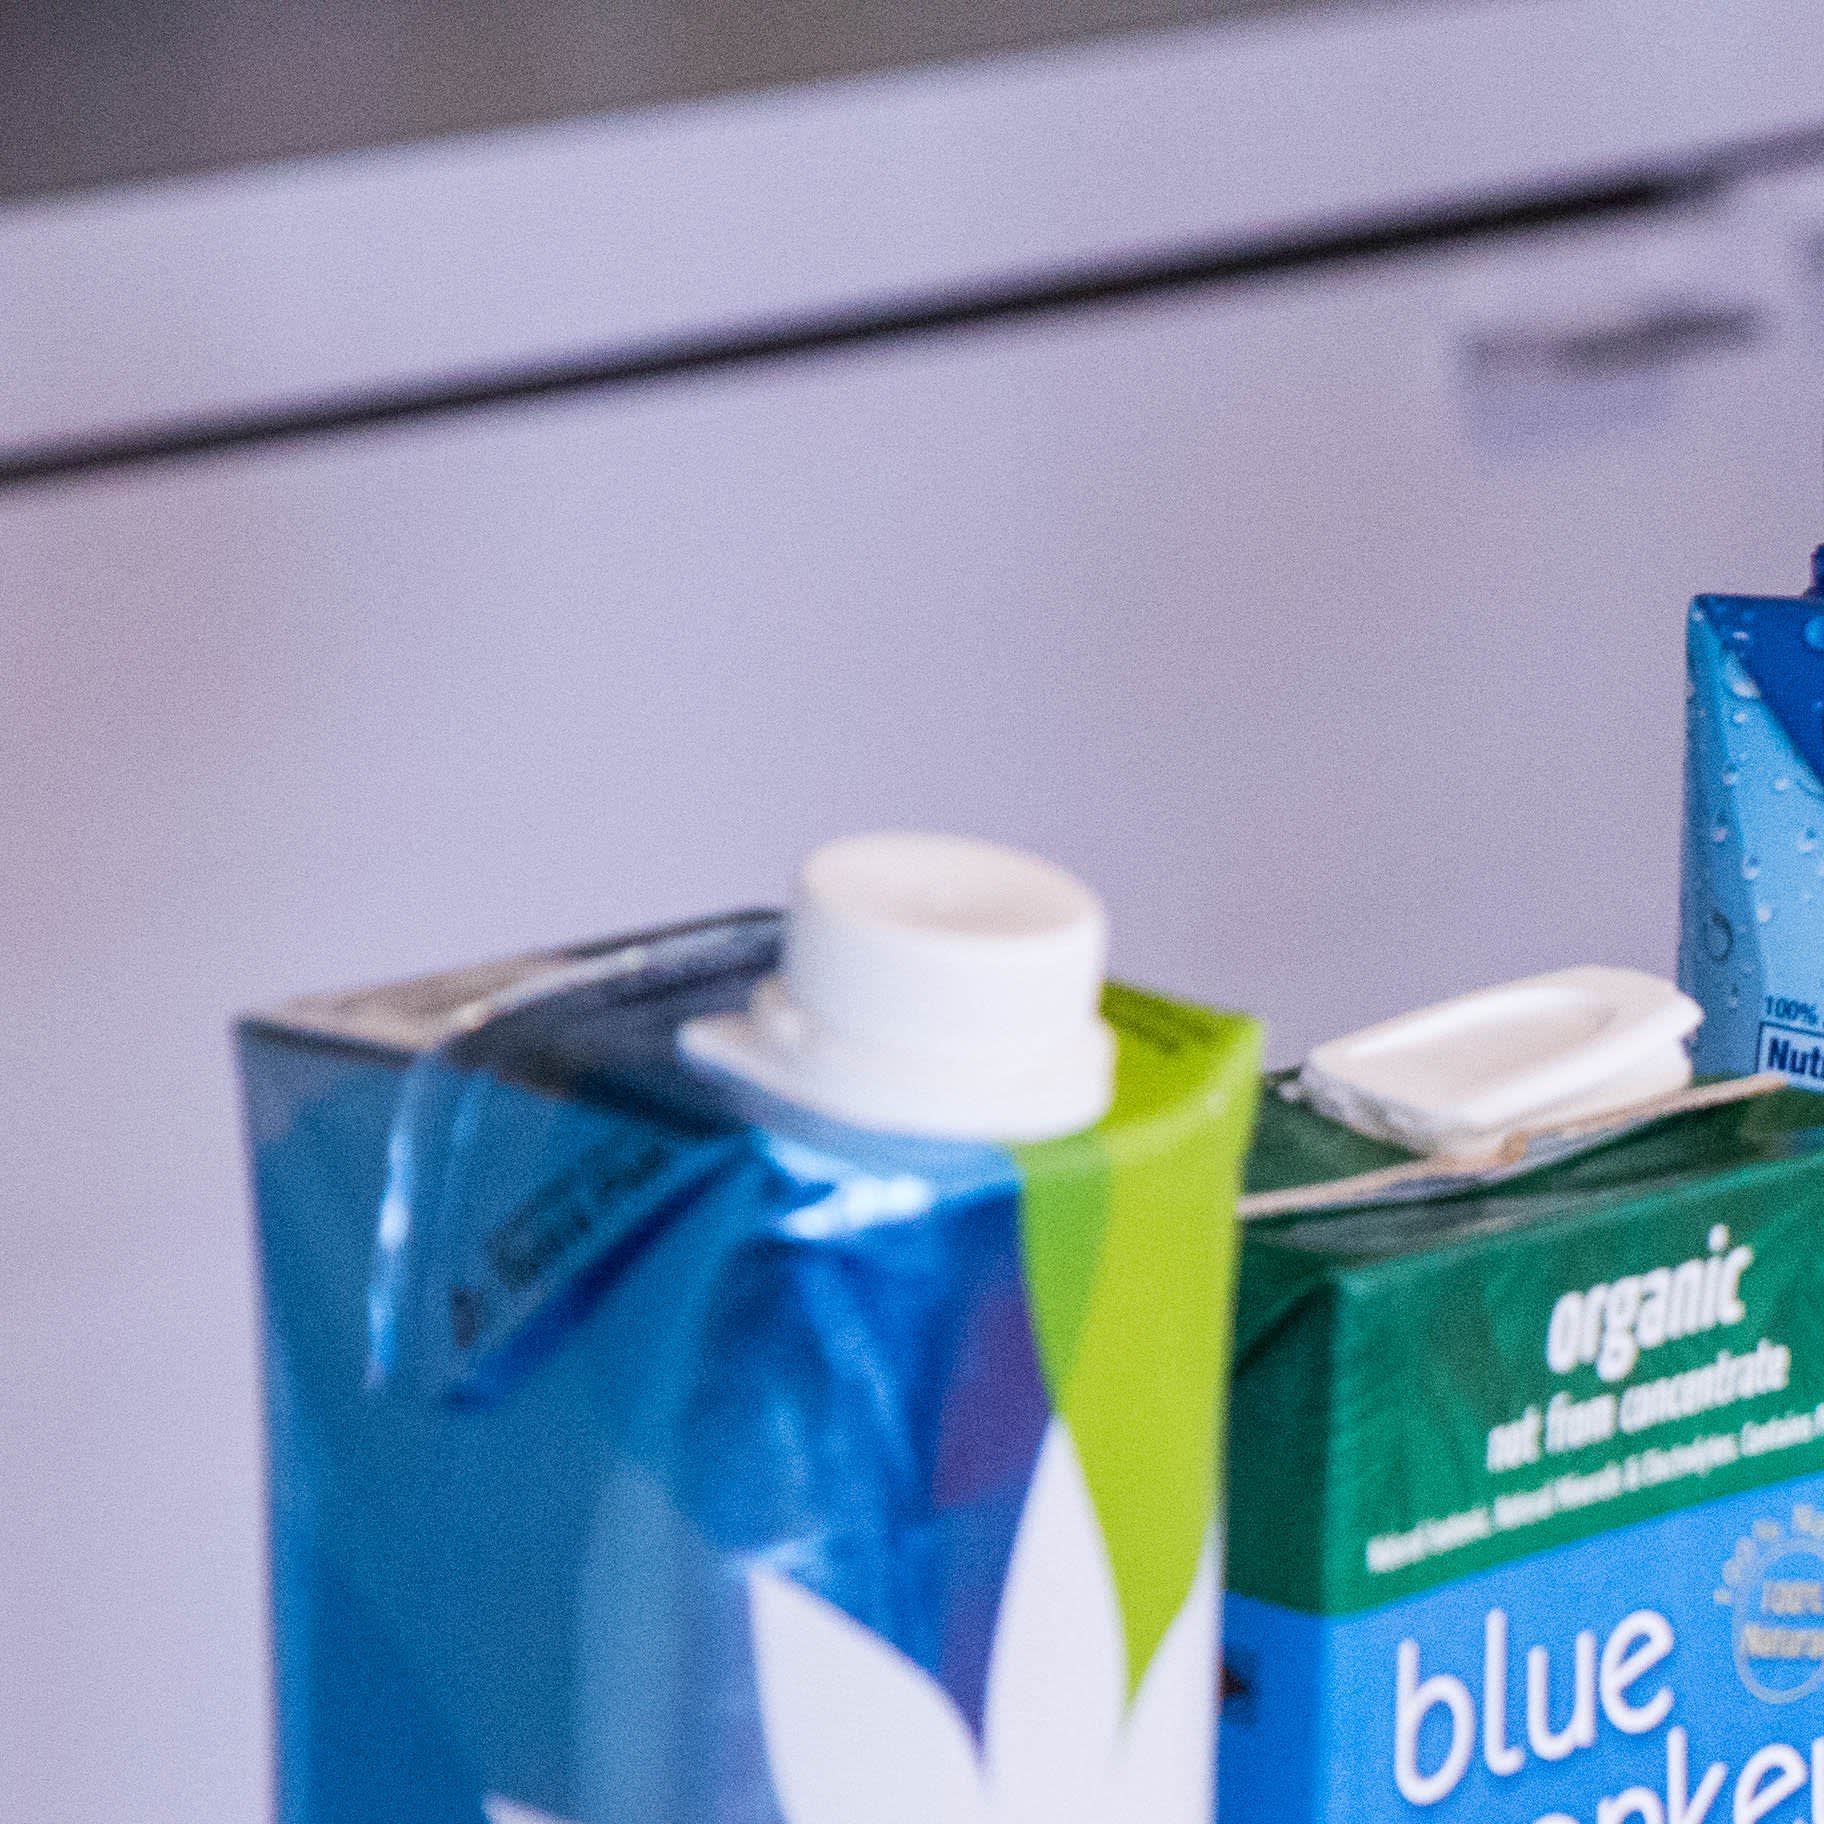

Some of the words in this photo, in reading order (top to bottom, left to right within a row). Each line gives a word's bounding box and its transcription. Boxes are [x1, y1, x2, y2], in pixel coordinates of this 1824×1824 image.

[1765, 996, 1818, 1025] 100%
[1546, 1222, 1753, 1382] organic
[1487, 1404, 1542, 1474] not
[1545, 1390, 1616, 1455] from
[1617, 1338, 1791, 1433] concentrate
[1396, 1608, 1674, 1806] blue
